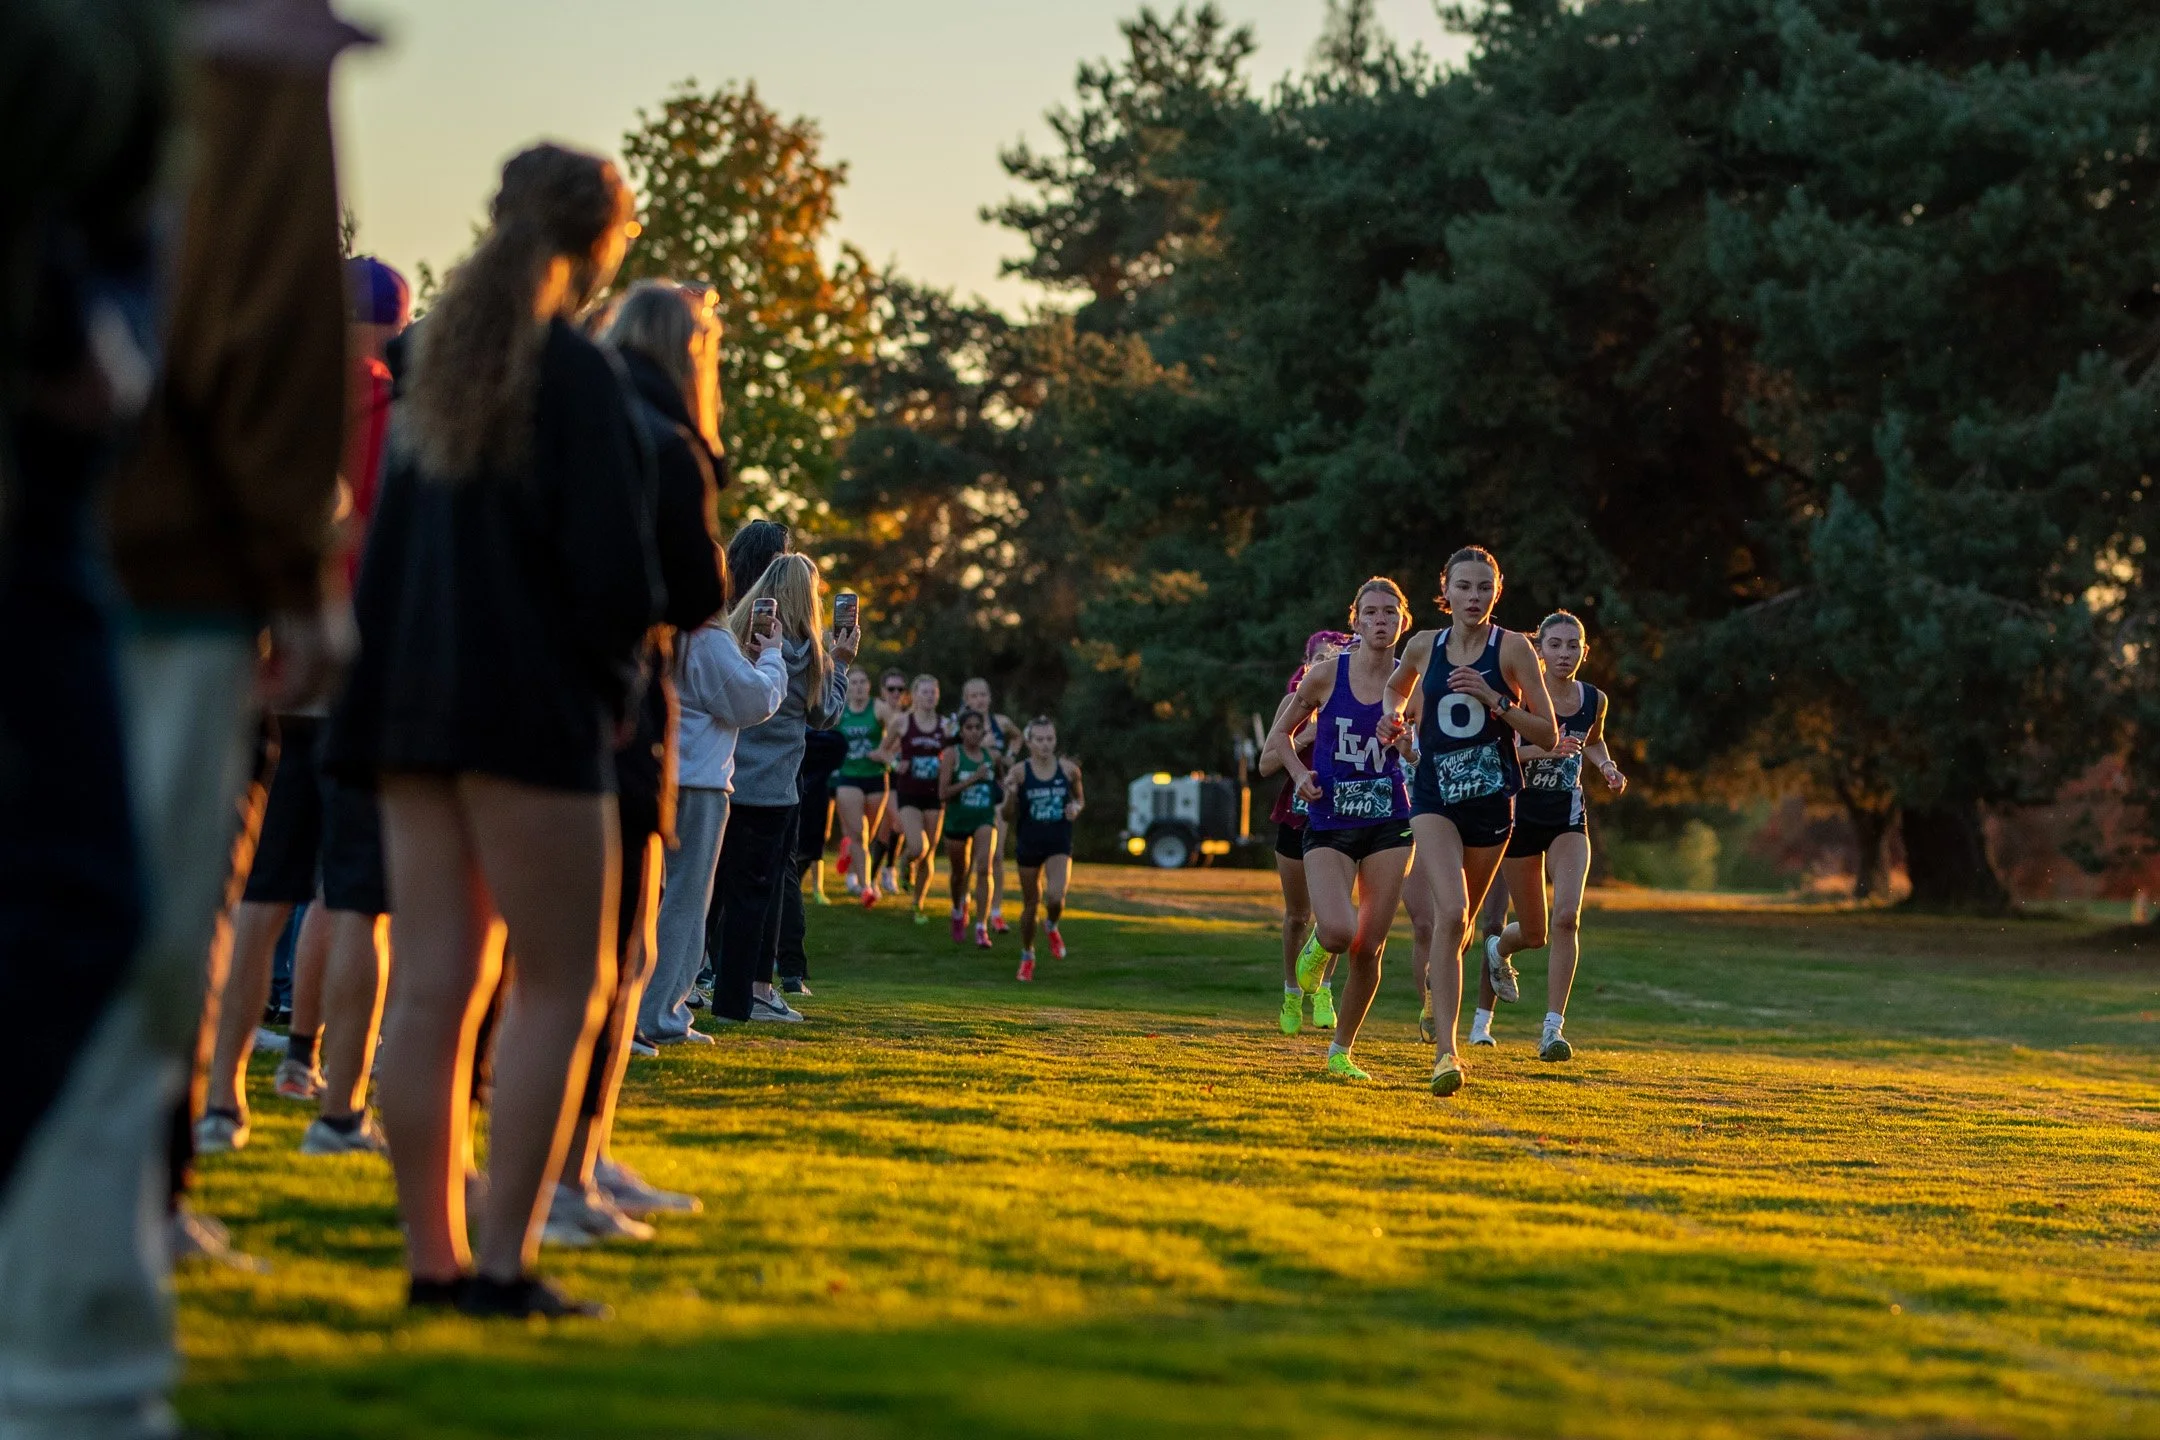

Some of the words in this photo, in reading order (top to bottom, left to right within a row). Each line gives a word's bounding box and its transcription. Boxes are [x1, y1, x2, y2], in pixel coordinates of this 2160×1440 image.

[1437, 693, 1486, 738] O
[1439, 748, 1475, 772] TWILIGHT
[1449, 762, 1465, 777] XC
[1532, 772, 1558, 788] 848
[1345, 783, 1361, 794] XC
[1341, 800, 1372, 816] 1440
